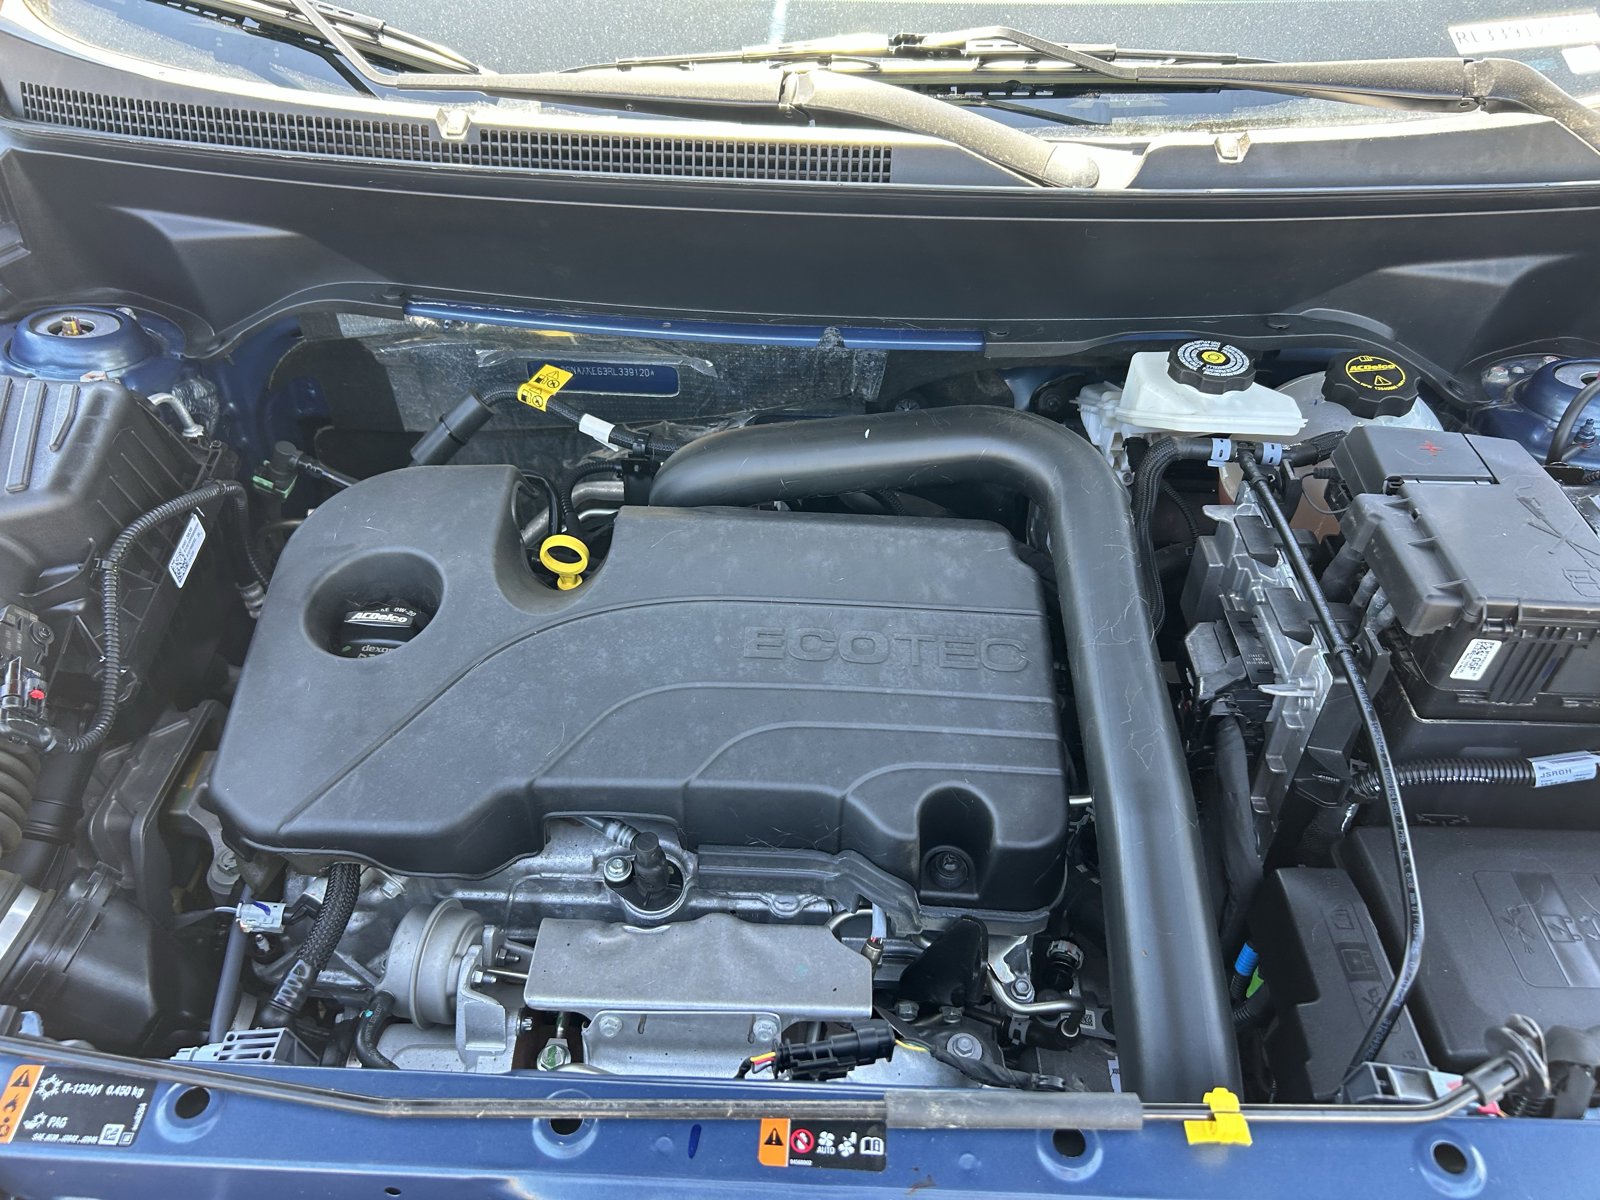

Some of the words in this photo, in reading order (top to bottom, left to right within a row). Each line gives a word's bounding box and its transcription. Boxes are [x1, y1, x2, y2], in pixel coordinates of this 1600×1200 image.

[351, 612, 408, 623] ACDelco
[743, 626, 1029, 673] ECOTEC
[62, 1083, 104, 1097] R-1234yf
[131, 1087, 145, 1099] kg
[47, 1116, 69, 1129] PAG
[816, 1146, 836, 1155] AUTO
